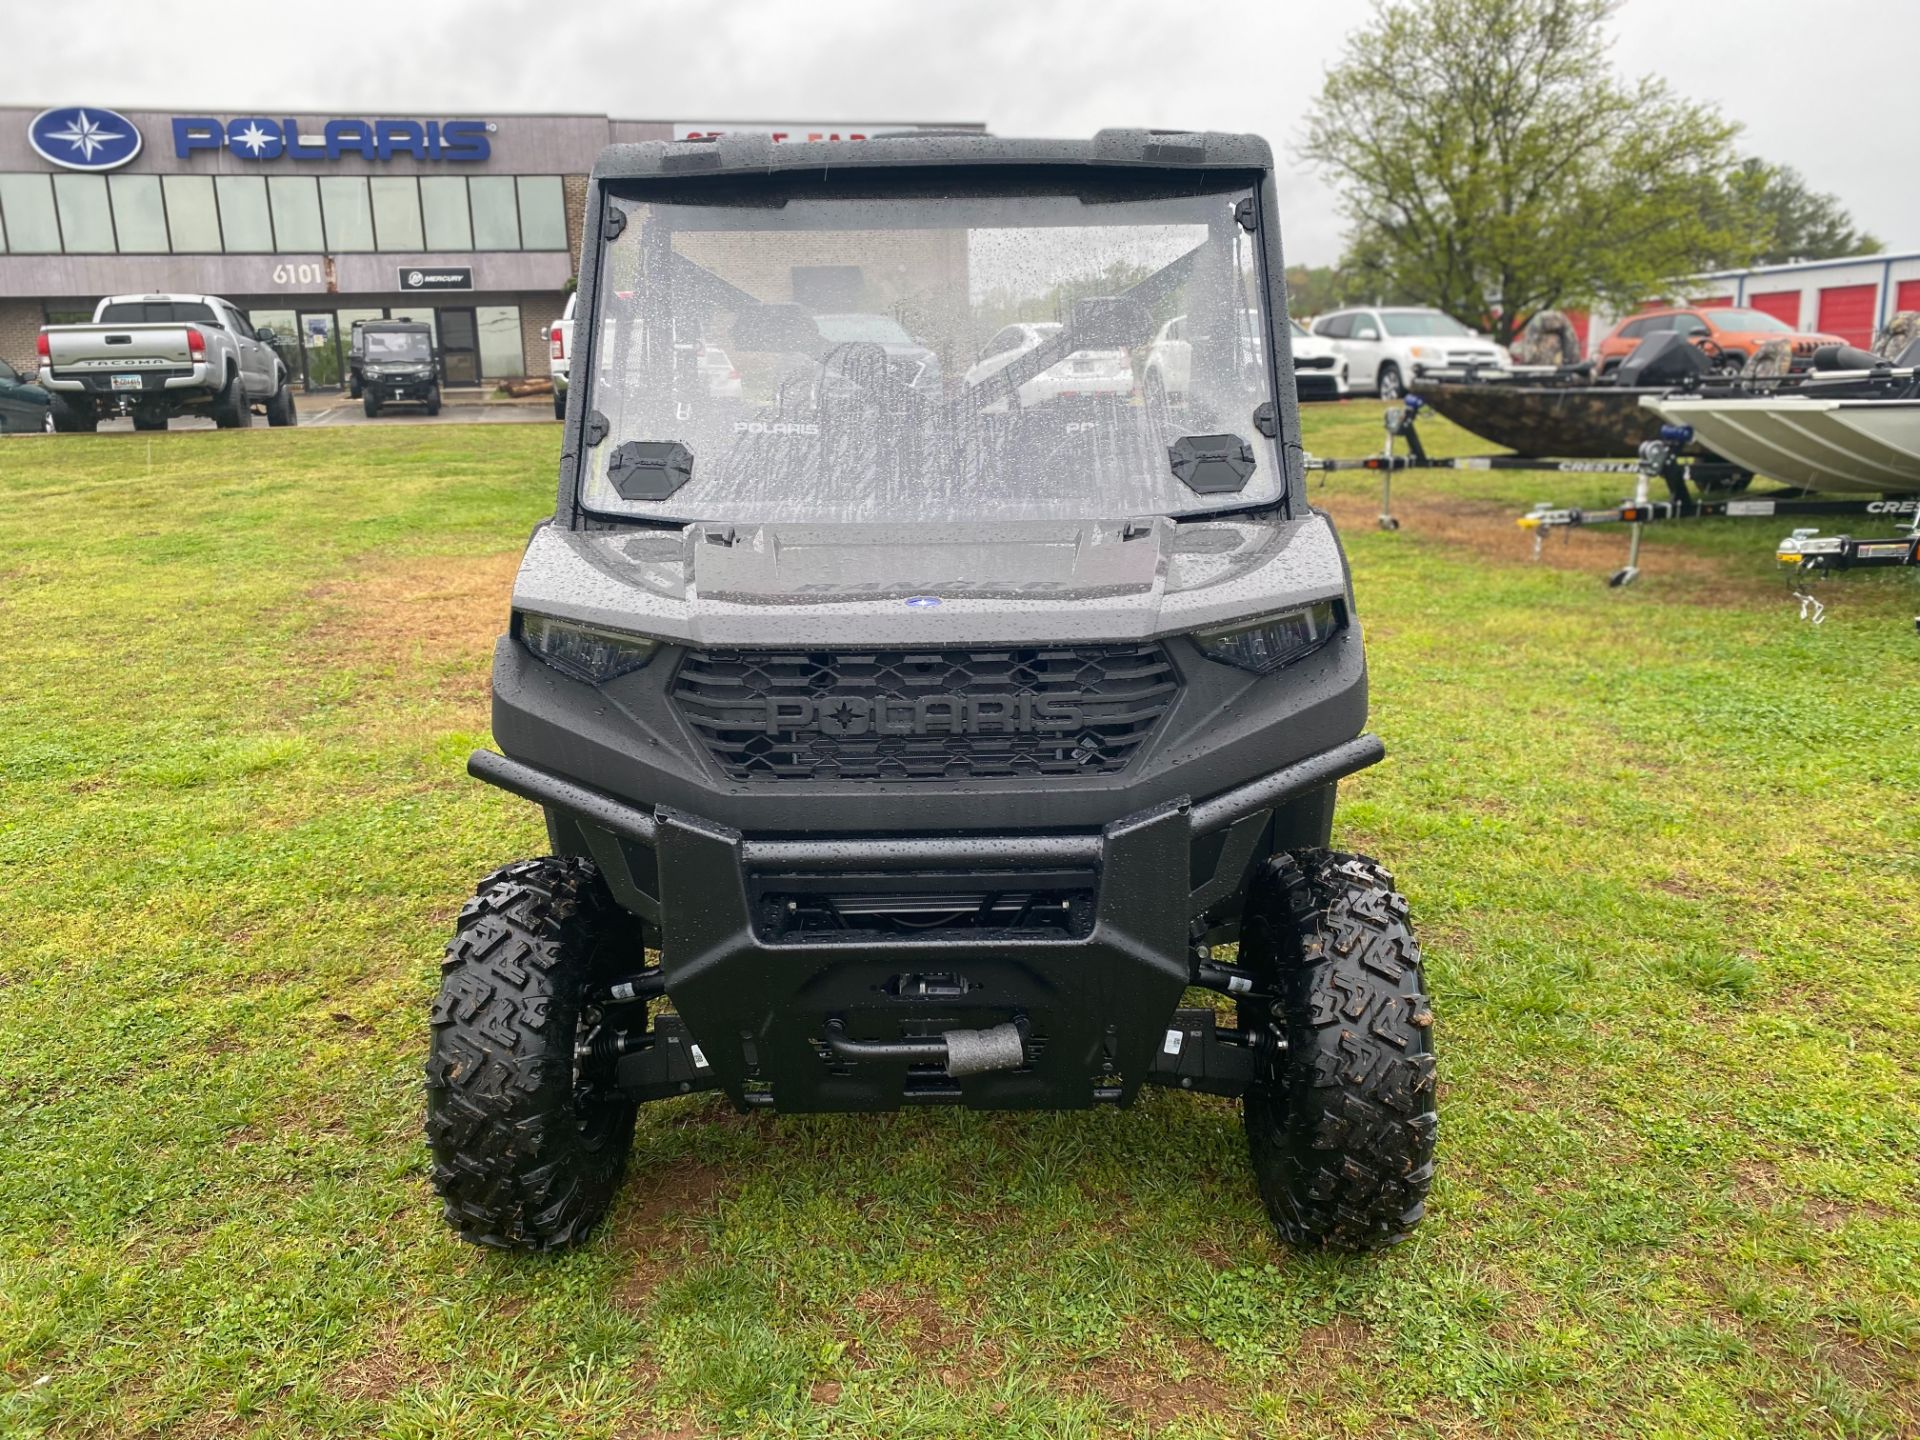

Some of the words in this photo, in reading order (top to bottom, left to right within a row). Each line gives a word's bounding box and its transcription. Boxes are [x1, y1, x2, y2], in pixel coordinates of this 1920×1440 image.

[171, 117, 492, 161] POLARIS
[272, 263, 322, 284] 6101
[733, 422, 819, 435] POLARIS
[765, 693, 1084, 735] POLARIS
